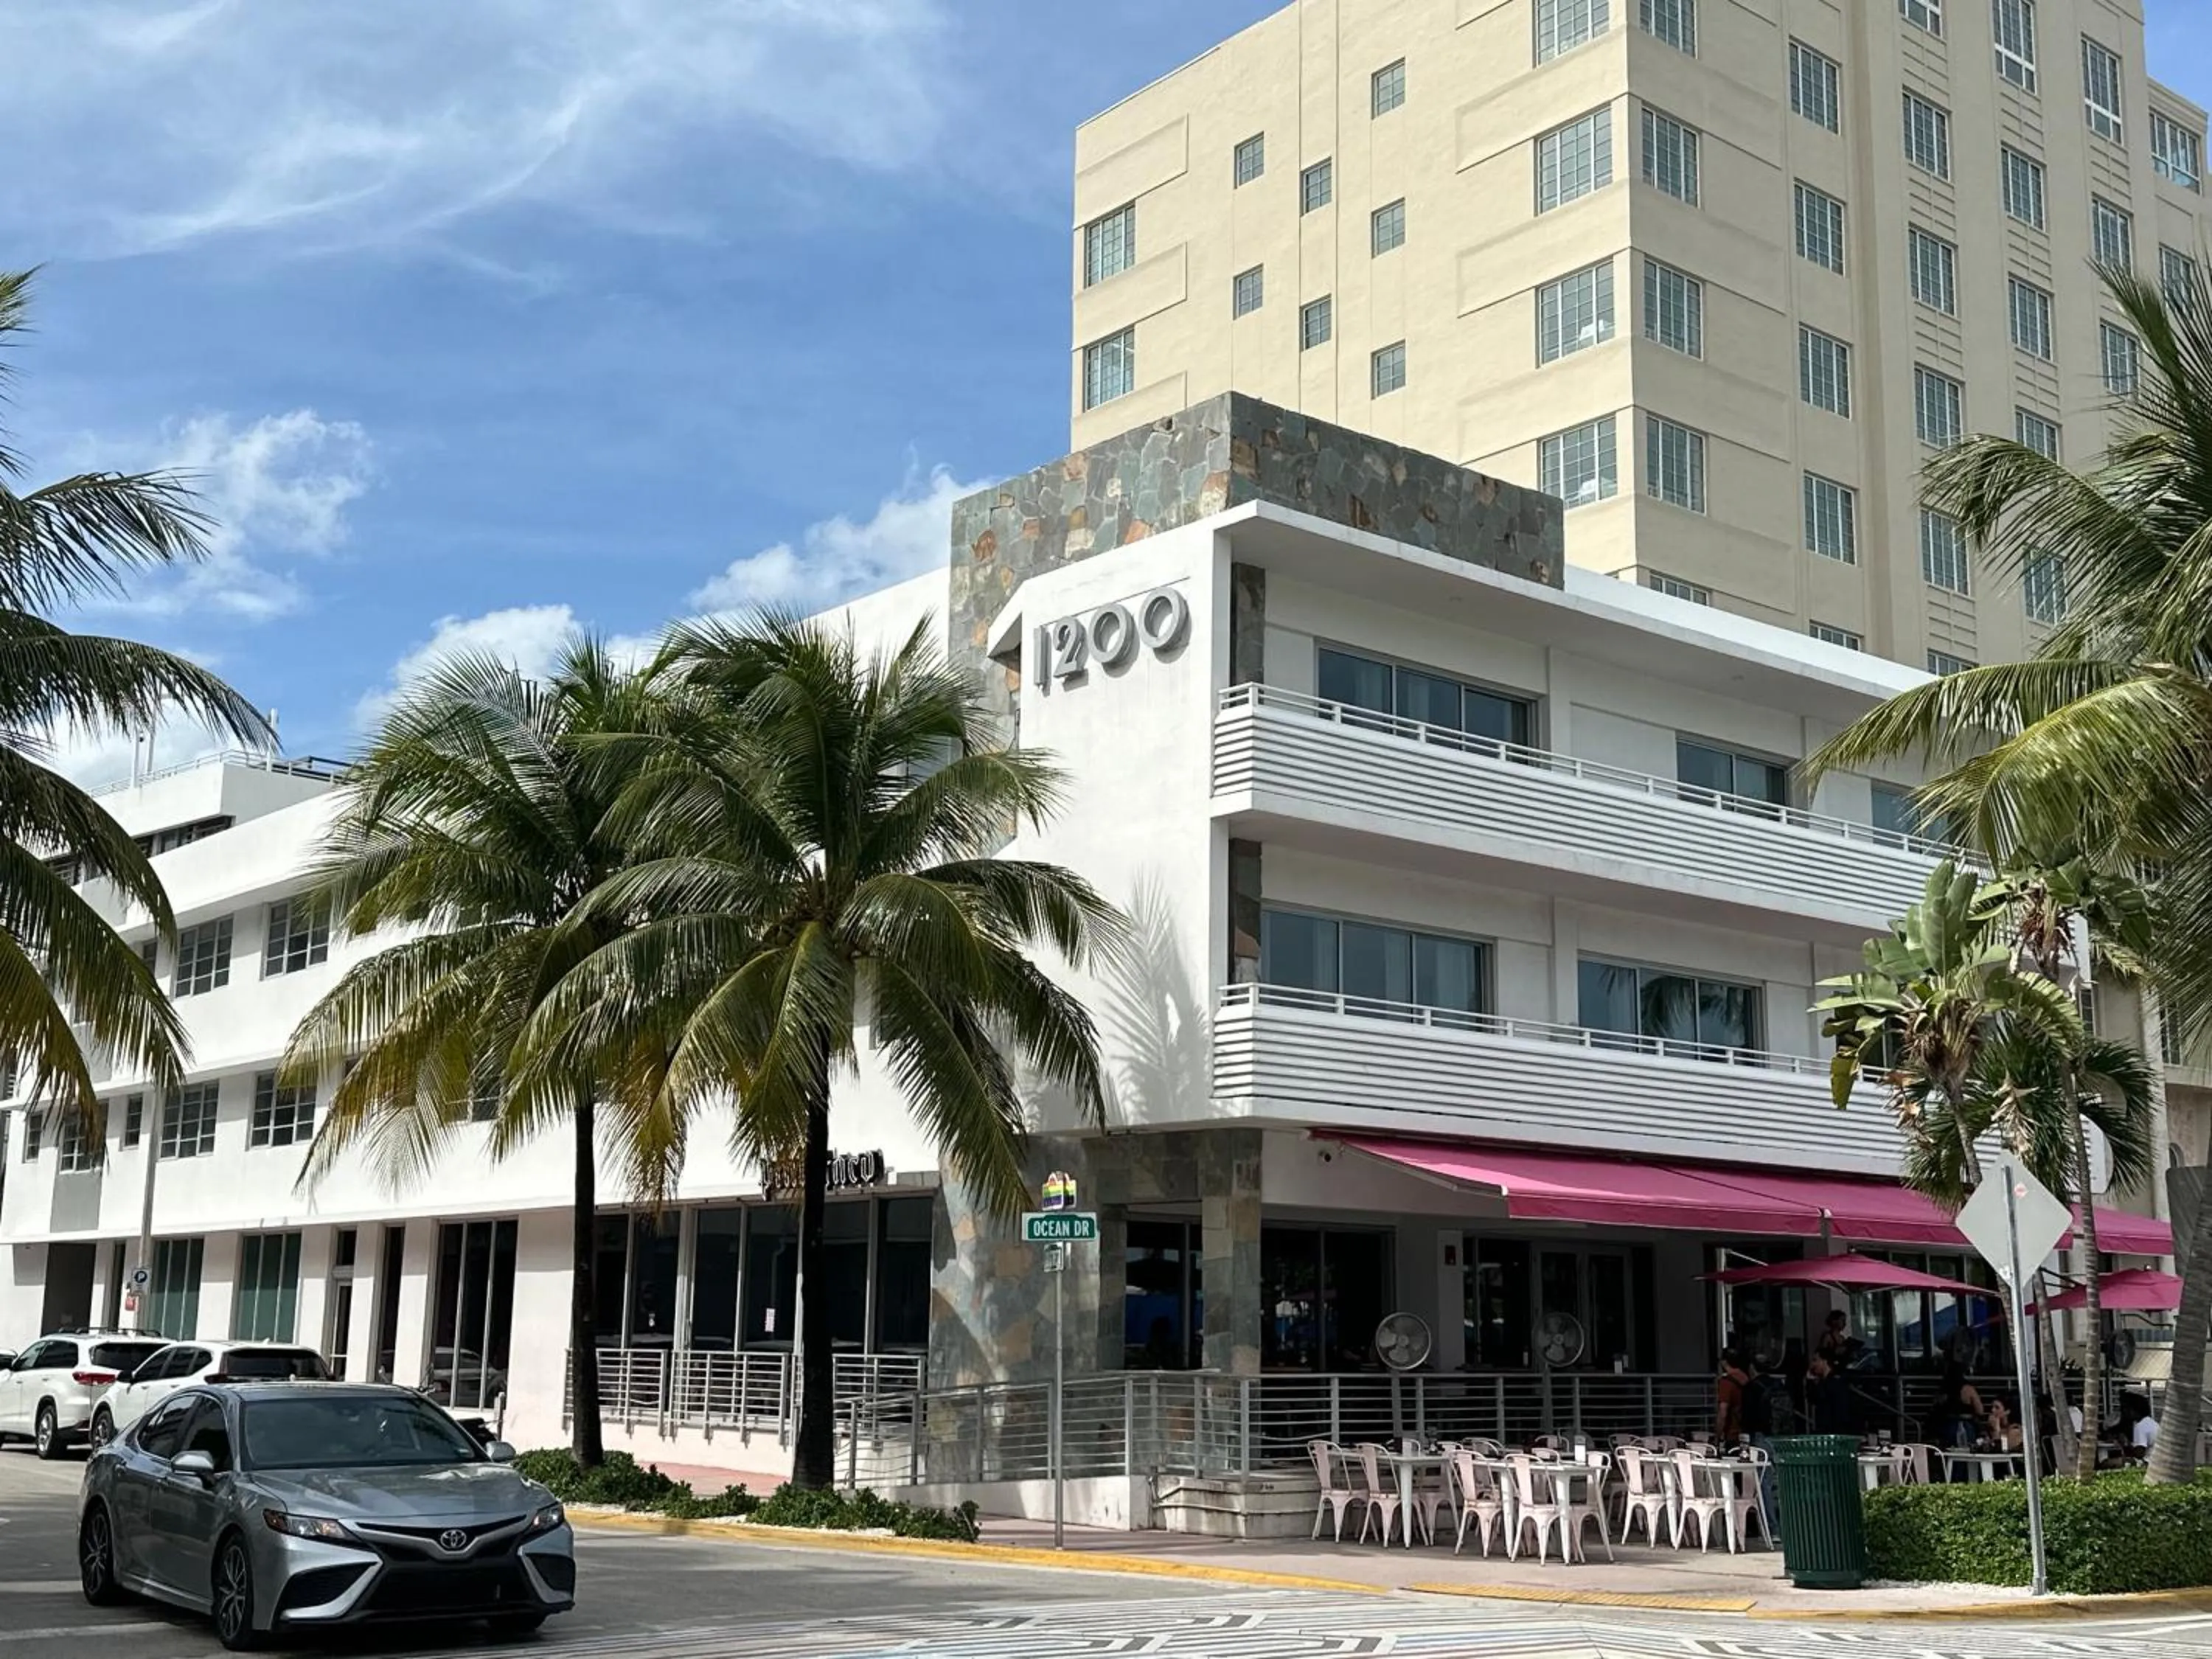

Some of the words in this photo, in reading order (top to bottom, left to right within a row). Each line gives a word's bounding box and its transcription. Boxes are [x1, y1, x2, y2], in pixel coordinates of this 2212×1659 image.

[1033, 587, 1189, 687] 1200
[1033, 1220, 1070, 1237] OCEAN
[1074, 1220, 1089, 1237] DR
